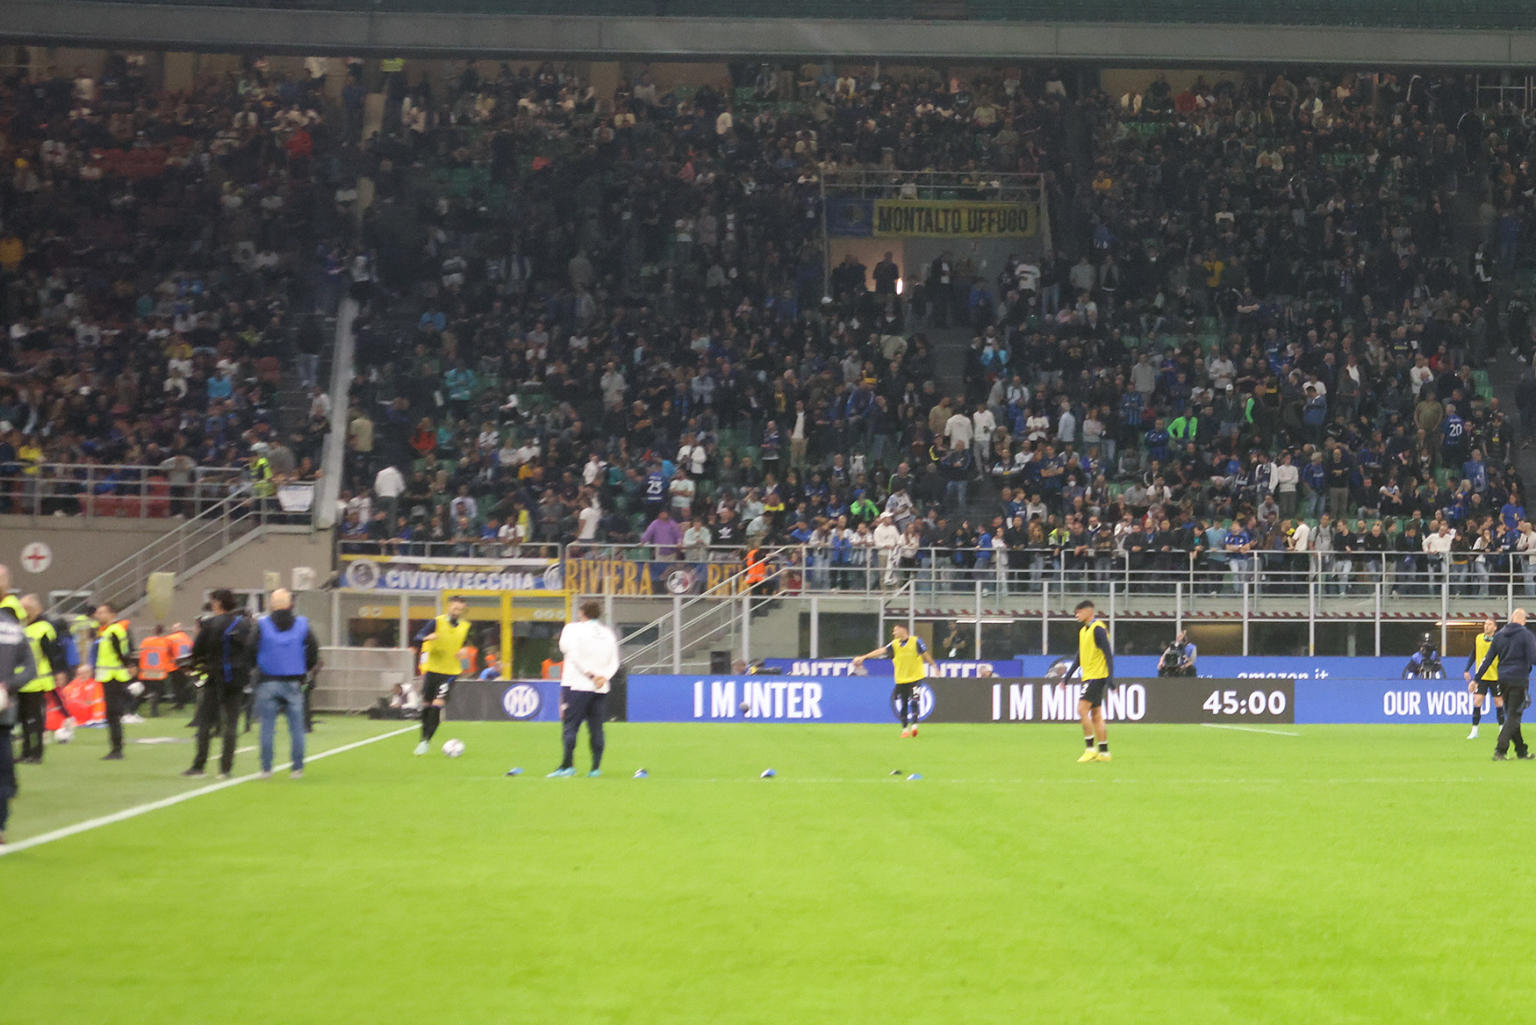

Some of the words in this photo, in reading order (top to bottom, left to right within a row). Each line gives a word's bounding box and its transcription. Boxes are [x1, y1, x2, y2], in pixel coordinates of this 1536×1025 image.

[878, 206, 961, 233] MONTALTO
[967, 207, 1029, 233] UFFUGO
[385, 569, 536, 590] CIVITAVECCHIA
[565, 559, 653, 595] RIVIERA
[711, 681, 736, 718] M
[744, 681, 823, 719] INTER
[1009, 683, 1033, 721] M
[1041, 683, 1147, 721] MILNO
[1202, 690, 1287, 716] 45:00
[1383, 690, 1422, 716] OUR
